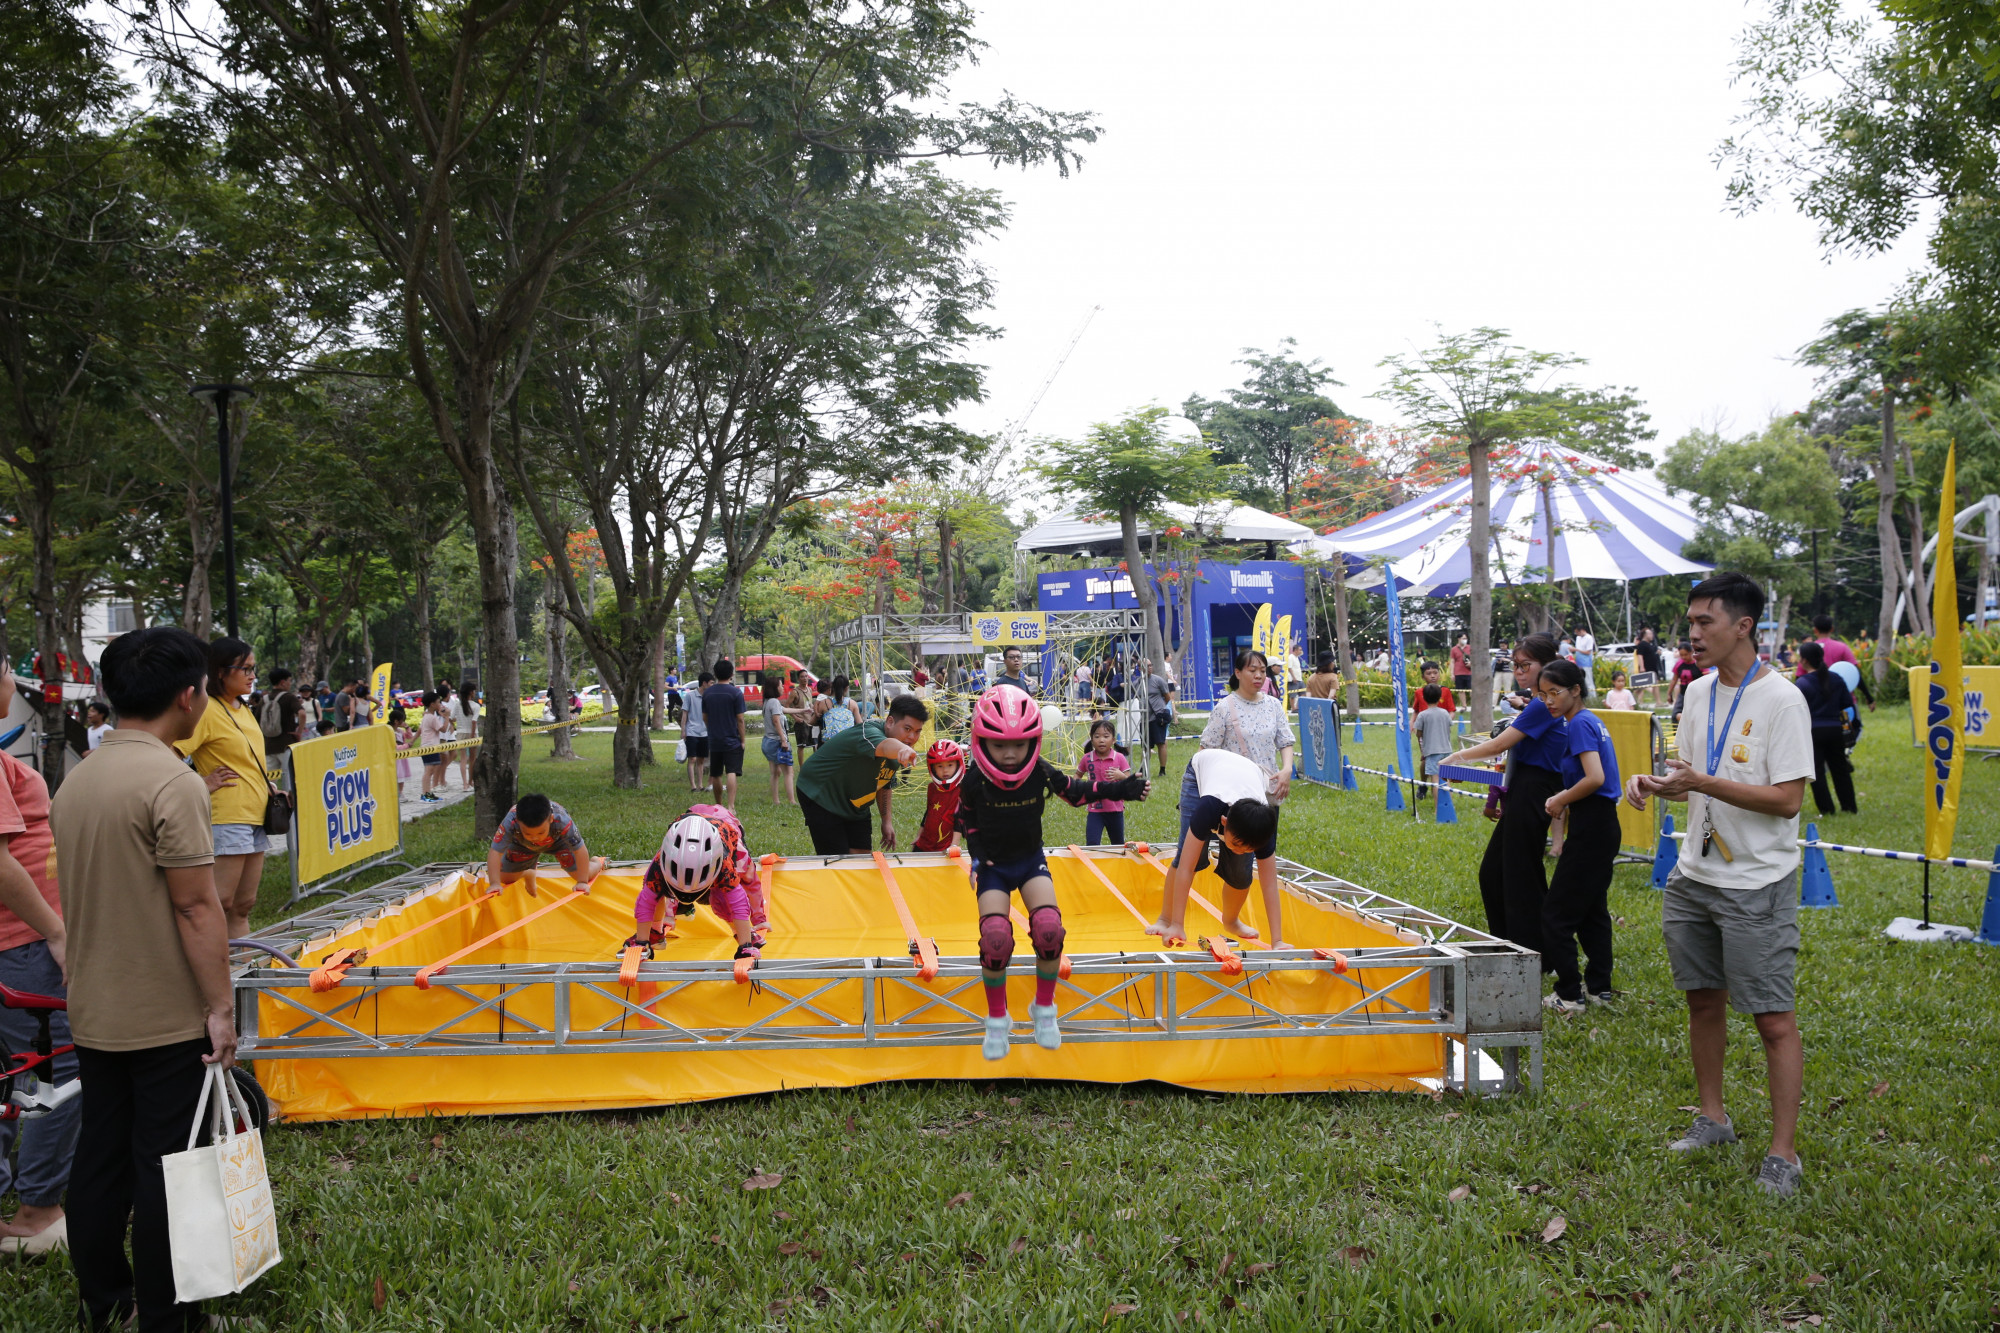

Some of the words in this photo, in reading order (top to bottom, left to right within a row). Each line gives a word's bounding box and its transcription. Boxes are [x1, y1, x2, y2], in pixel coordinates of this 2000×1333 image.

[1086, 575, 1135, 595] Vinamil
[1230, 570, 1274, 587] Vinamilk
[1010, 621, 1039, 630] Grow
[1012, 629, 1042, 639] PLUS+
[323, 767, 370, 811] Grow
